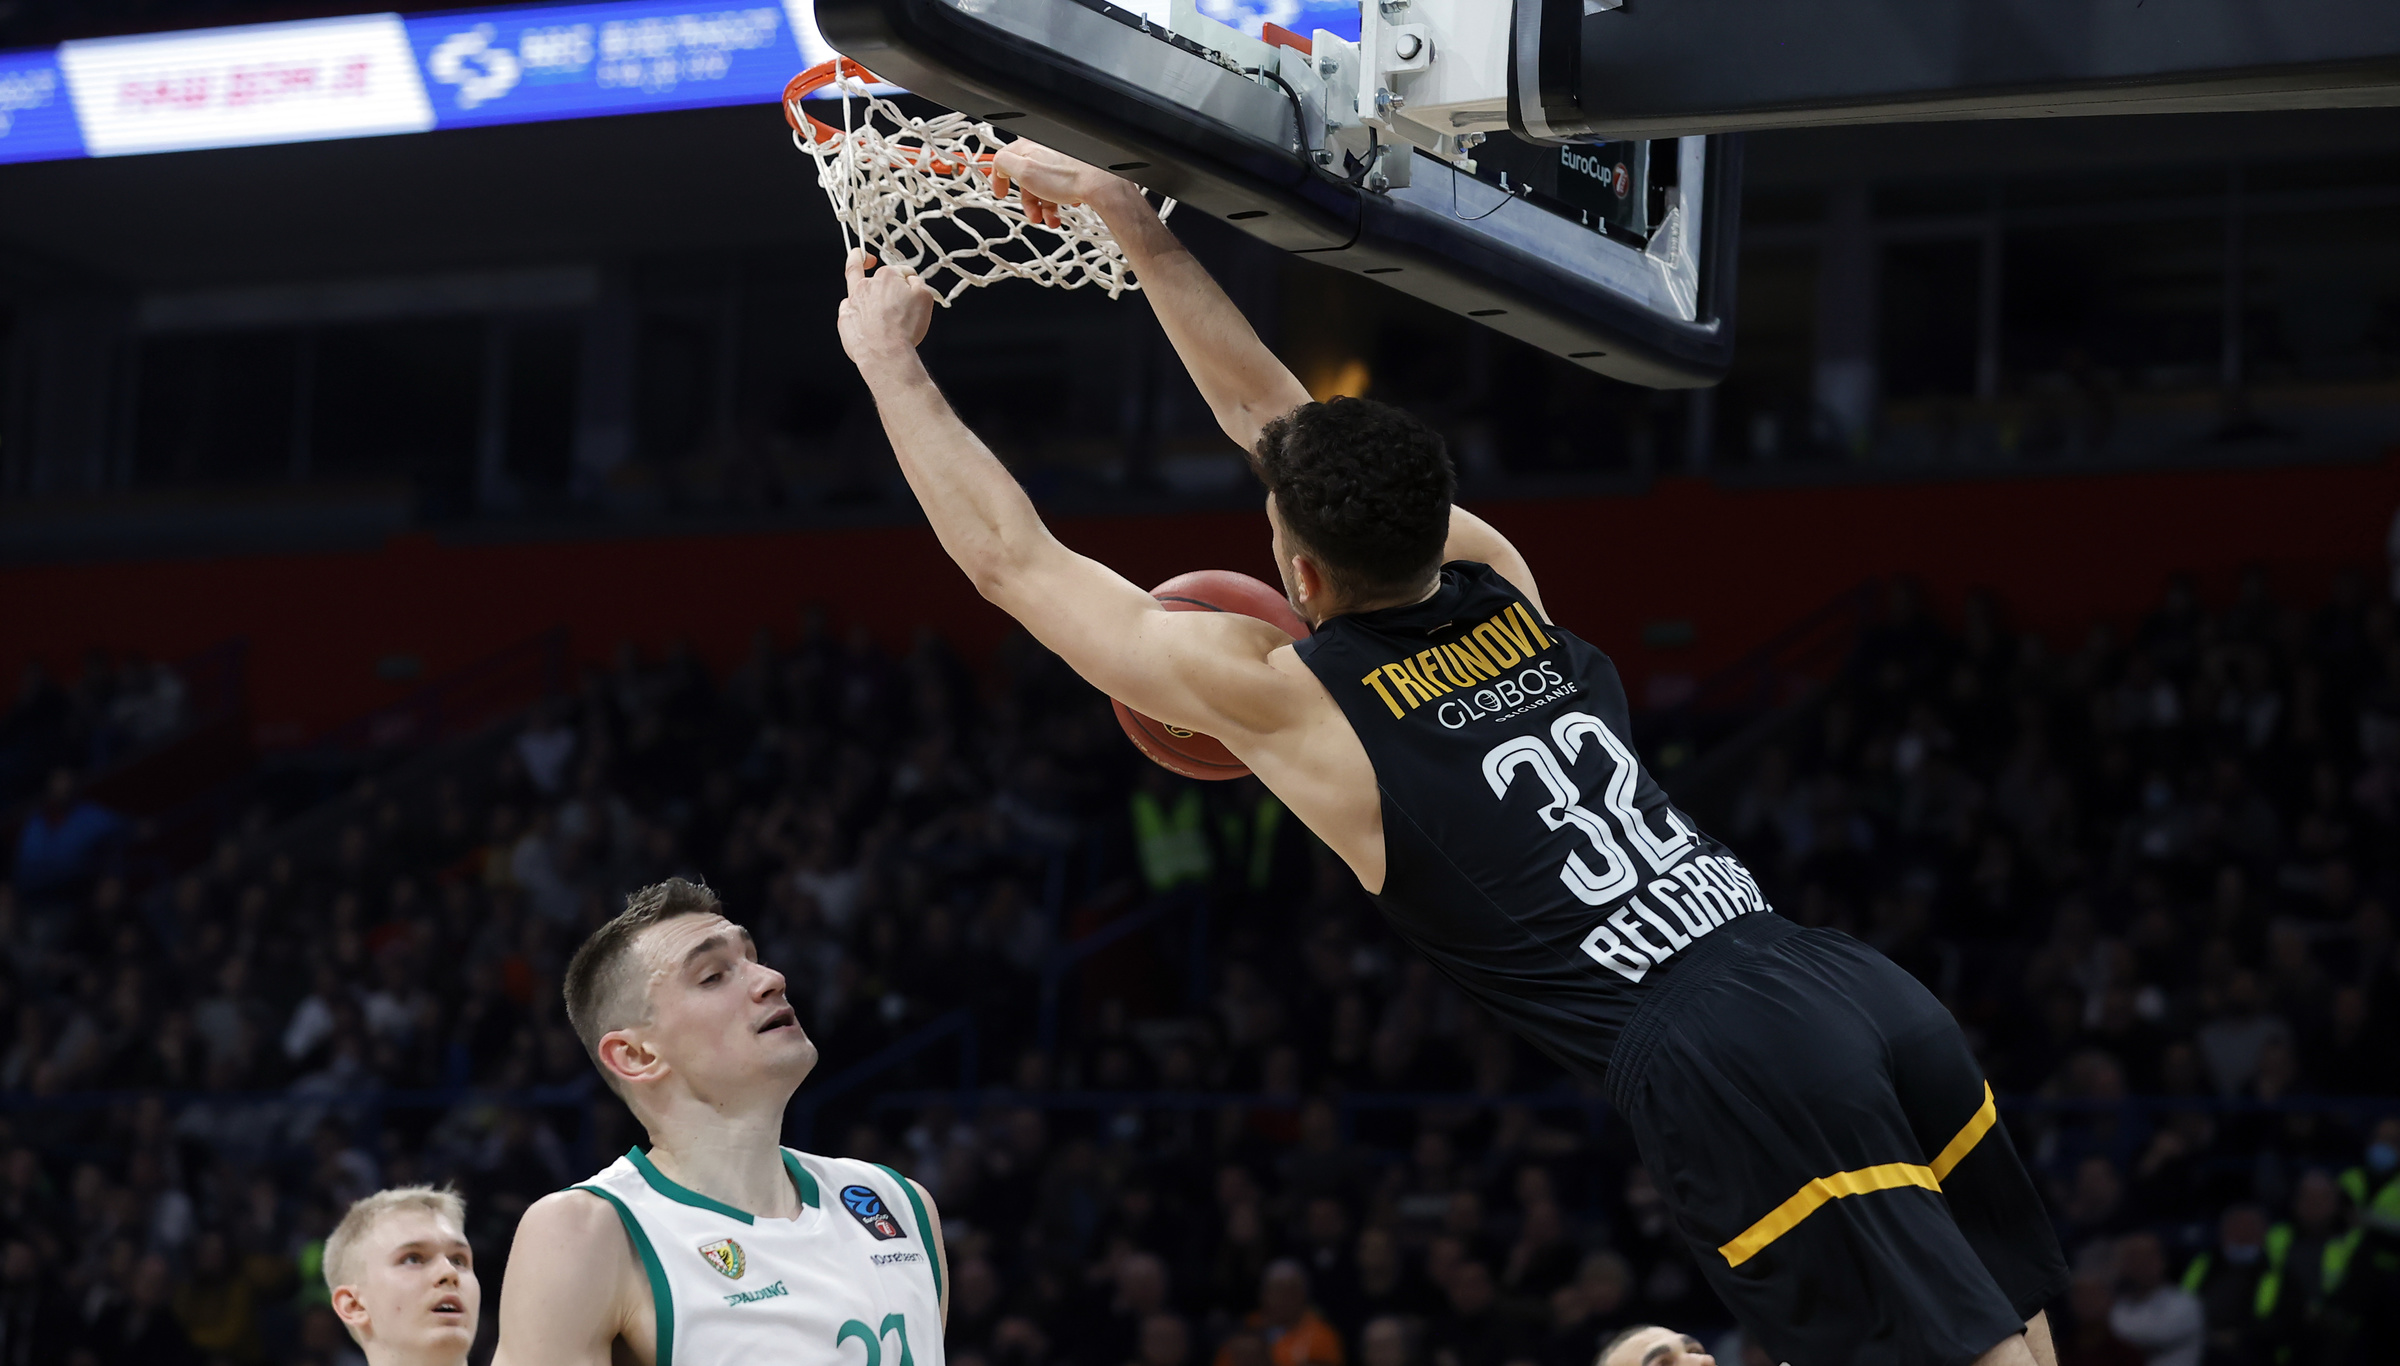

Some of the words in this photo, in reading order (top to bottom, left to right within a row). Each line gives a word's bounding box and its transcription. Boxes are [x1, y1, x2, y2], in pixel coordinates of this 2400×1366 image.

[1560, 144, 1612, 188] EuroCup
[1361, 601, 1559, 720] TRIFUNOVI
[1437, 660, 1563, 730] GLOBOS
[1494, 681, 1578, 724] OSIGURANJE
[1481, 711, 1702, 906] 32
[1579, 854, 1774, 984] BELGRAD
[723, 1279, 789, 1308] SPALDING
